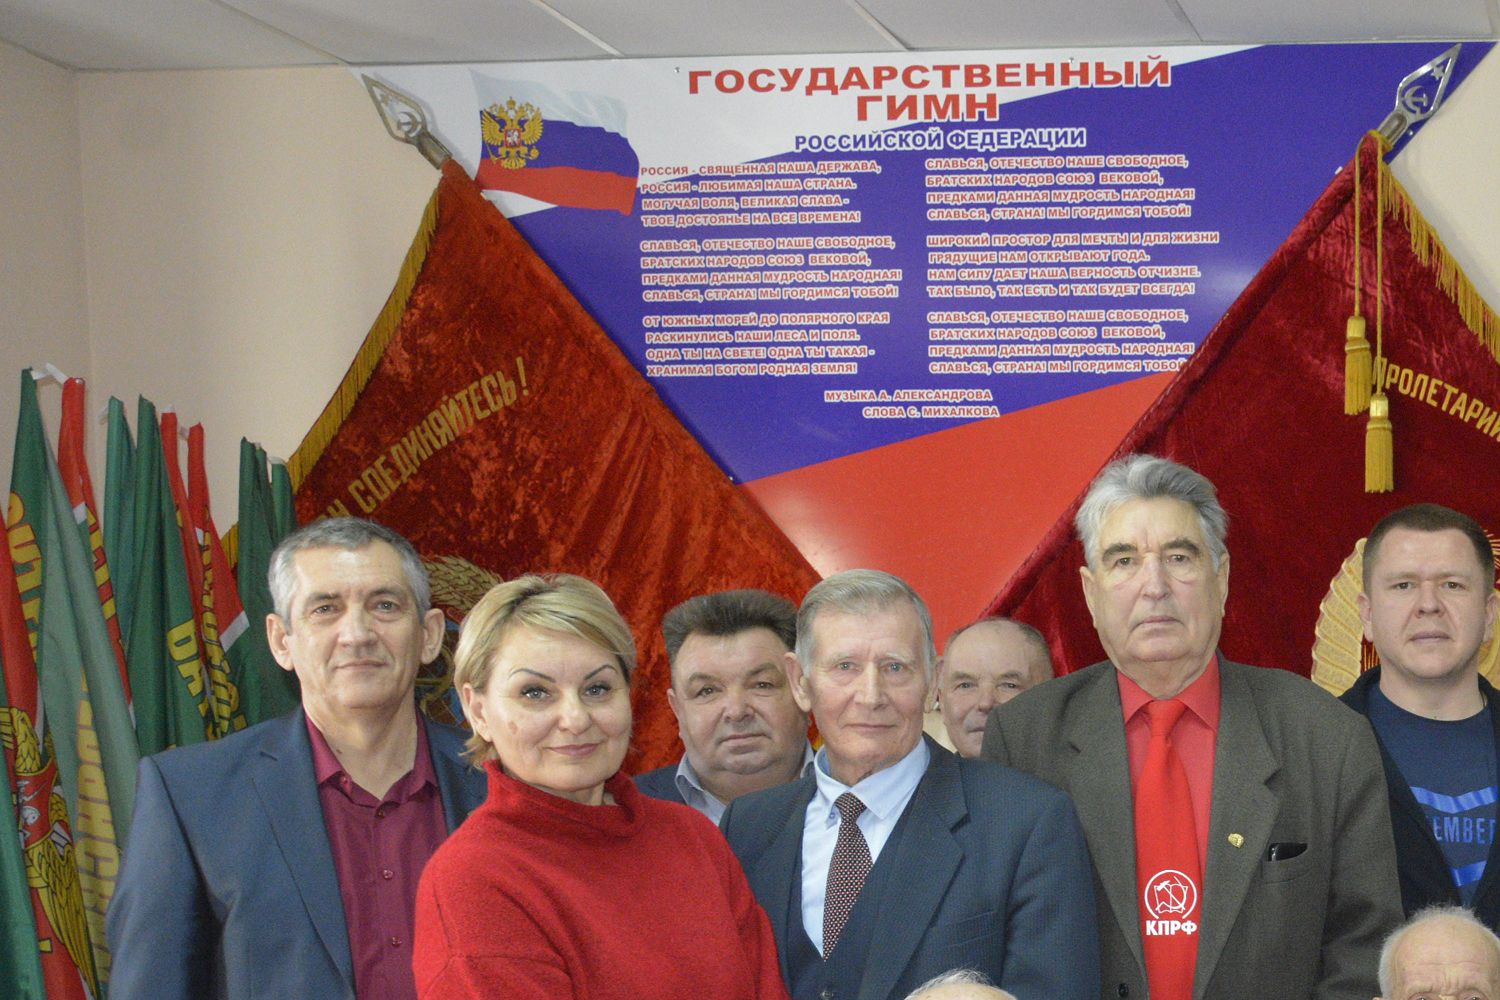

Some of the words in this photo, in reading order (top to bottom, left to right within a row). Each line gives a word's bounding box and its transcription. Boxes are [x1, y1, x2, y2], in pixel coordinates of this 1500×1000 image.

[688, 54, 1170, 96] ГОСУДАРСТВЕННЫЙ
[856, 93, 999, 122] ГИМН
[794, 129, 942, 151] РОССИЙСКОЙ
[948, 128, 1086, 150] ФЕДЕРАЦИИ
[639, 165, 690, 176] РОССИЯ
[699, 164, 775, 177] СВЯЩЕННАЯ
[777, 163, 814, 174] НАША
[818, 162, 881, 175] ДЕРЖАВА,
[926, 158, 988, 171] СЛАВЬСЯ,
[990, 157, 1064, 168] ОТЕЧЕСТВО
[1066, 157, 1103, 167] НАШЕ
[1107, 156, 1187, 169] СВОБОДНОЕ,
[641, 182, 690, 193] РОССИЯ
[699, 180, 763, 192] ЛЮБИМАЯ
[764, 180, 801, 191] НАША
[804, 179, 856, 190] СТРАНА.
[926, 175, 992, 186] БРАТСКИХ
[994, 174, 1054, 187] НАРОДОВ
[1057, 174, 1094, 185] СОЮЗ
[1100, 171, 1163, 186] ВЕКОВОЙ,
[642, 198, 699, 209] МОГУЧАЯ
[701, 197, 739, 210] ВОЛЯ,
[741, 196, 798, 207] ВЕЛИКАЯ
[800, 195, 842, 206] СЛАВА
[927, 191, 996, 204] ПРЕДКАМИ
[998, 191, 1049, 204] ДАННАЯ
[1052, 190, 1118, 203] МУДРОСТЬ
[1122, 189, 1194, 202] НАРОДНАЯ!
[642, 215, 673, 226] ТВОЕ
[677, 214, 749, 227] ДОСТОЯНЬЕ
[752, 214, 770, 224] НА
[772, 213, 795, 224] ВСЕ
[799, 212, 860, 224] ВРЕМЕНА!
[928, 208, 990, 221] СЛАВЬСЯ,
[992, 208, 1045, 219] СТРАНА!
[1047, 207, 1070, 218] МЫ
[1071, 207, 1142, 220] ГОРДИМСЯ
[1144, 204, 1191, 217] ТОБОЙ!
[640, 240, 701, 253] СЛАВЬСЯ,
[703, 239, 774, 250] ОТЕЧЕСТВО
[777, 238, 813, 249] НАШЕ
[815, 237, 894, 250] СВОБОДНОЕ,
[927, 233, 990, 246] ШИРОКИЙ
[992, 234, 1050, 245] ПРОСТОР
[1053, 234, 1081, 246] ДЛЯ
[1082, 233, 1128, 244] МЕЧТЫ
[1130, 233, 1141, 244] И
[1143, 233, 1170, 245] ДЛЯ
[1173, 232, 1220, 243] ЖИЗНИ
[642, 256, 704, 267] БРАТСКИХ
[706, 255, 765, 268] НАРОДОВ
[766, 255, 804, 266] СОЮЗ
[809, 252, 871, 267] ВЕКОВОЙ,
[929, 252, 996, 265] ГРЯДУЩИЕ
[999, 252, 1028, 262] НАМ
[1030, 251, 1109, 262] ОТКРЫВАЮТ
[1112, 251, 1149, 263] ГОДА.
[642, 273, 708, 286] ПРЕДКАМИ
[710, 272, 761, 285] ДАННАЯ
[763, 271, 828, 284] МУДРОСТЬ
[831, 270, 901, 283] НАРОДНАЯ!
[928, 269, 957, 280] НАМ
[959, 269, 991, 279] СИЛУ
[994, 268, 1026, 281] ДАЕТ
[1030, 268, 1067, 279] НАША
[1070, 267, 1136, 278] ВЕРНОСТЬ
[1138, 267, 1199, 278] ОТЧИЗНЕ.
[643, 289, 703, 302] СЛАВЬСЯ,
[706, 289, 755, 300] СТРАНА!
[758, 288, 781, 299] МЫ
[783, 287, 850, 300] ГОРДИМСЯ
[853, 285, 897, 298] ТОБОЙ!
[928, 286, 952, 297] ТАК
[954, 286, 995, 298] БЫЛО,
[999, 286, 1022, 296] ТАК
[1024, 285, 1056, 296] ЕСТЬ
[1058, 285, 1069, 296] И
[1073, 285, 1096, 295] ТАК
[1099, 284, 1137, 297] БУДЕТ
[1142, 284, 1195, 297] ВСЕГДА!
[644, 316, 659, 327] ОТ
[662, 315, 712, 326] ЮЖНЫХ
[716, 313, 757, 326] МОРЕЙ
[760, 314, 777, 327] ДО
[780, 313, 854, 325] ПОЛЯРНОГО
[856, 313, 890, 324] КРАЯ
[927, 312, 989, 324] СЛАВЬСЯ,
[991, 311, 1065, 322] ОТЕЧЕСТВО
[1067, 311, 1104, 321] НАШЕ
[1107, 310, 1187, 323] СВОБОДНОЕ,
[645, 332, 733, 343] РАСКИНУЛИСЬ
[735, 331, 773, 342] НАШИ
[776, 331, 807, 342] ЛЕСА
[809, 331, 820, 341] И
[822, 330, 860, 341] ПОЛЯ.
[930, 329, 994, 339] БРАТСКИХ
[998, 328, 1057, 341] НАРОДОВ
[1058, 328, 1097, 339] СОЮЗ
[1102, 325, 1165, 340] ВЕКОВОЙ,
[646, 349, 680, 361] ОДНА
[684, 348, 701, 359] ТЫ
[704, 348, 721, 359] НА
[724, 348, 765, 358] СВЕТЕ!
[768, 347, 802, 360] ОДНА
[806, 347, 824, 358] ТЫ
[828, 346, 868, 357] ТАКАЯ
[929, 345, 997, 358] ПРЕДКАМИ
[1000, 345, 1050, 358] ДАННАЯ
[1053, 344, 1119, 357] МУДРОСТЬ
[1122, 344, 1194, 356] НАРОДНАЯ!
[648, 365, 713, 376] ХРАНИМАЯ
[715, 364, 757, 375] БОГОМ
[759, 363, 810, 376] РОДНАЯ
[813, 363, 857, 374] ЗЕМЛЯ!
[930, 362, 992, 375] СЛАВЬСЯ,
[994, 362, 1047, 372] СТРАНА!
[1049, 362, 1071, 372] МЫ
[1073, 361, 1142, 374] ГОРДИМСЯ
[825, 391, 876, 401] МУЗЫКА
[879, 390, 891, 401] А.
[894, 390, 992, 403] АЛЕКСАНДРОВА
[864, 407, 905, 417] СЛОВА
[908, 407, 918, 417] С.
[922, 406, 999, 417] МИХАЛКОВА
[1145, 920, 1198, 936] КПРФ
